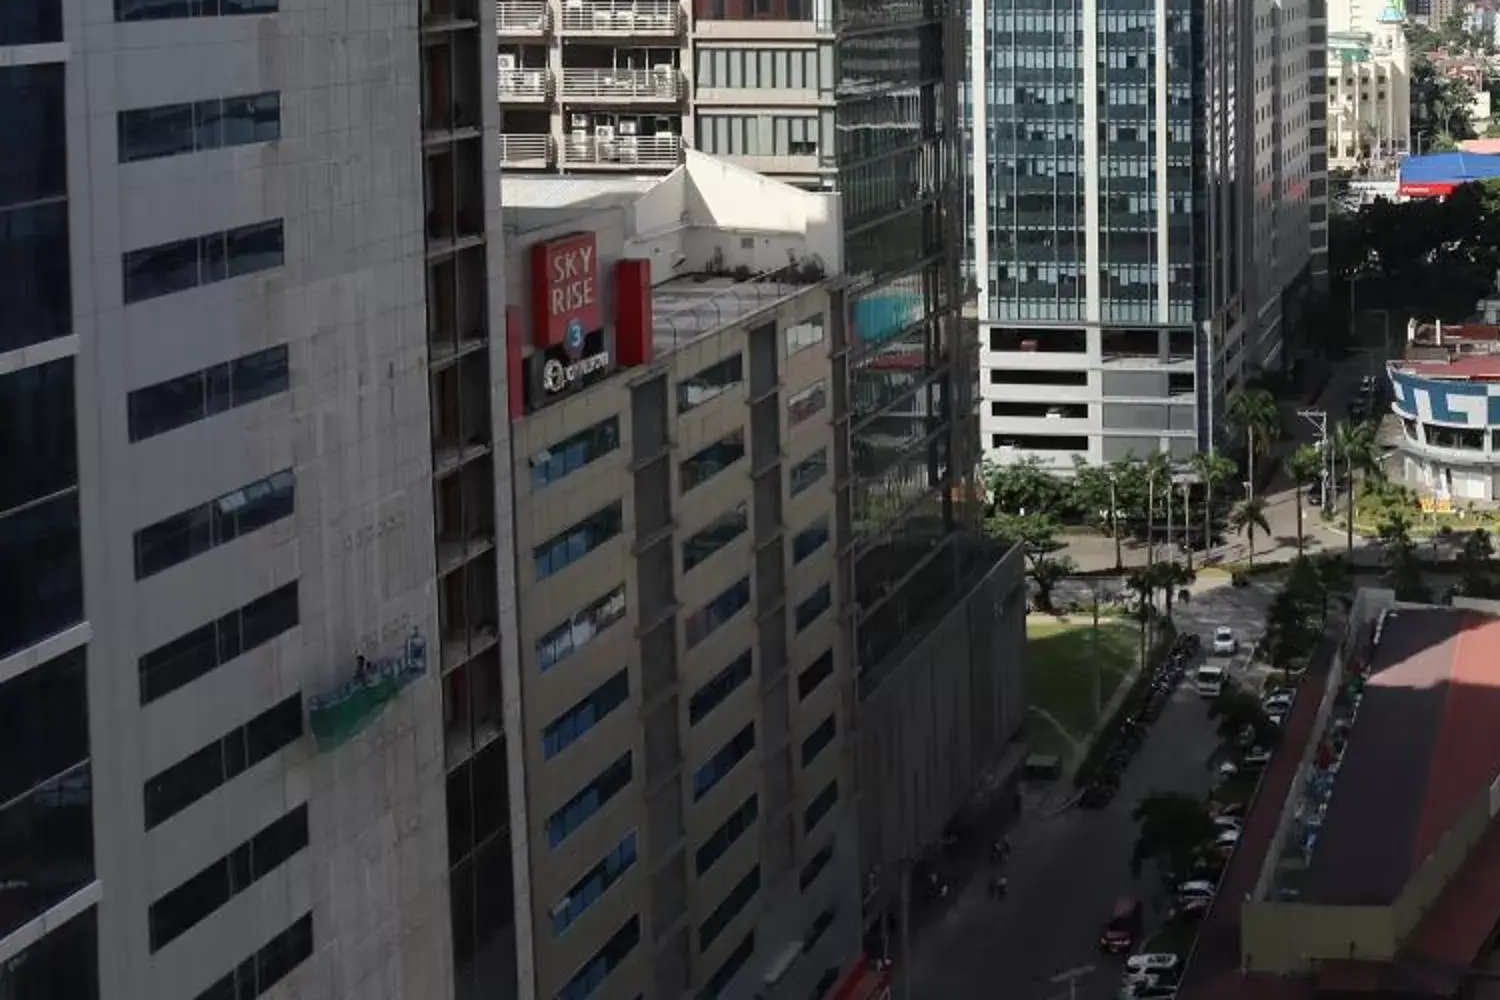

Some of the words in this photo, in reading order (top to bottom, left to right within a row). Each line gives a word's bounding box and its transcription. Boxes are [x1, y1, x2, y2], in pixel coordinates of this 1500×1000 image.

[553, 246, 593, 282] SKY
[552, 277, 593, 315] RISE
[570, 324, 581, 347] 3
